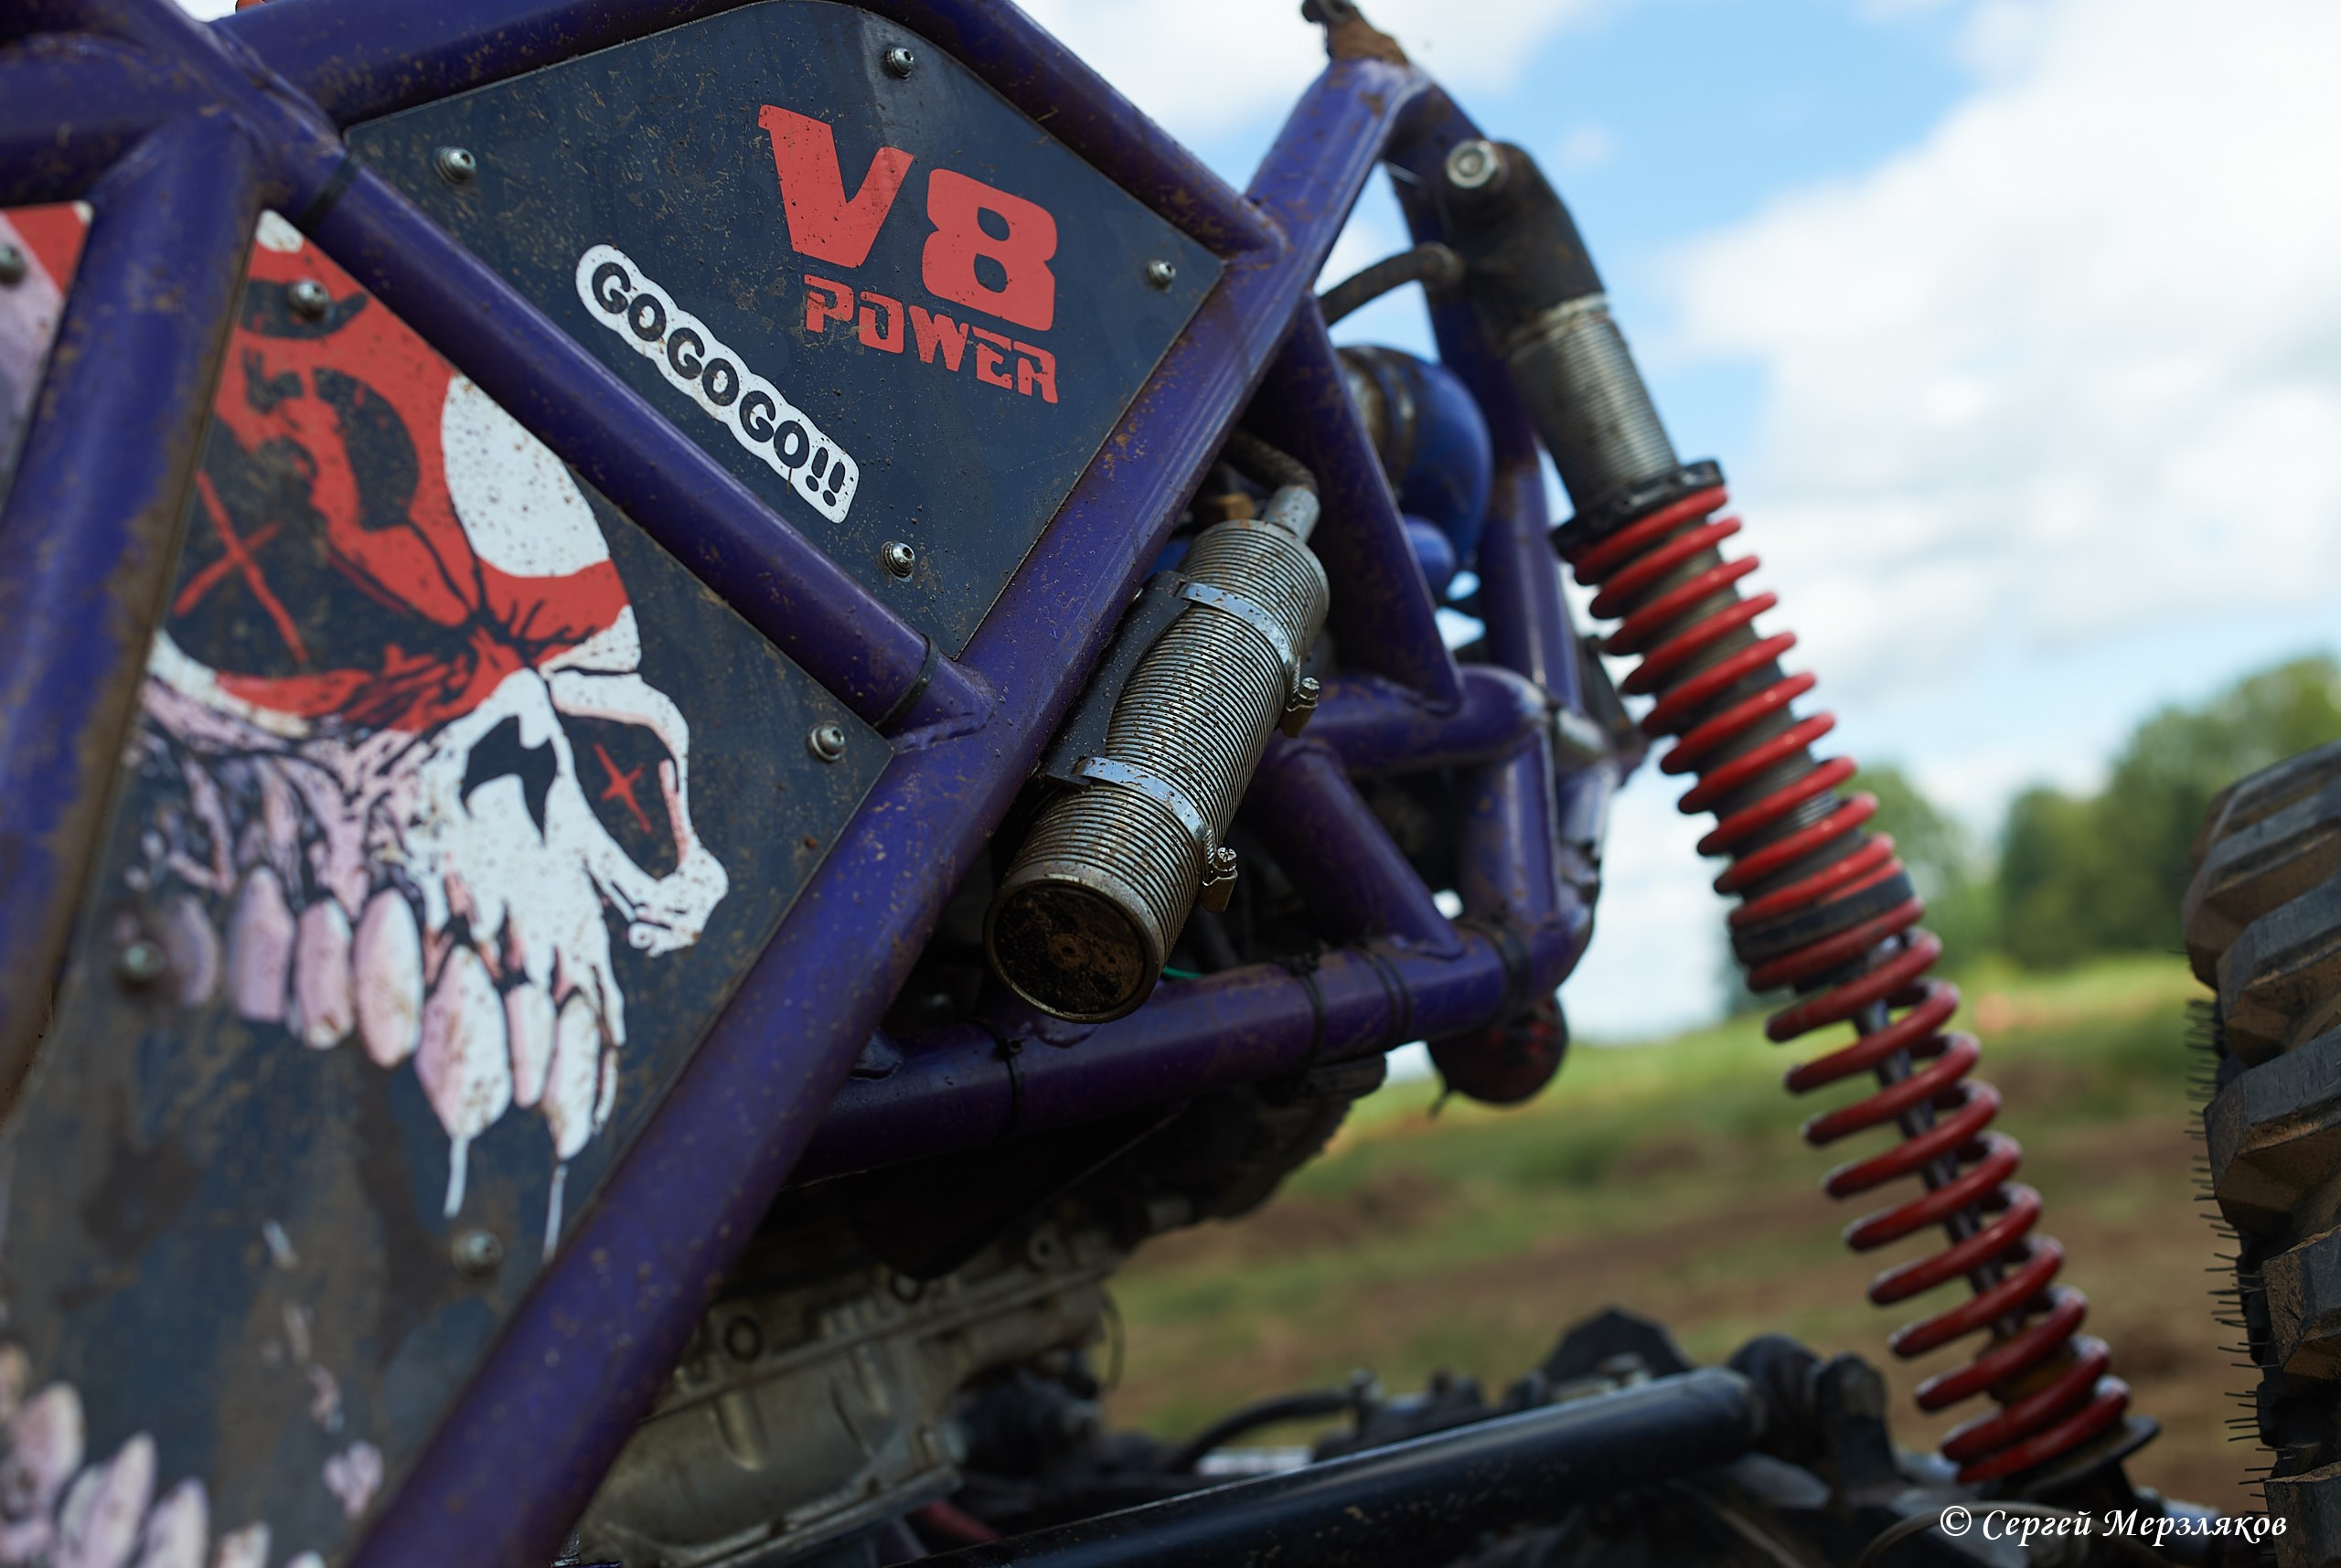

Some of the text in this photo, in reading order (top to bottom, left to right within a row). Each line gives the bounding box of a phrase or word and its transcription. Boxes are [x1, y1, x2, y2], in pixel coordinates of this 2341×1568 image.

[758, 104, 1058, 331] V8
[592, 261, 846, 507] GOGOGO!!
[804, 274, 1059, 404] POWER
